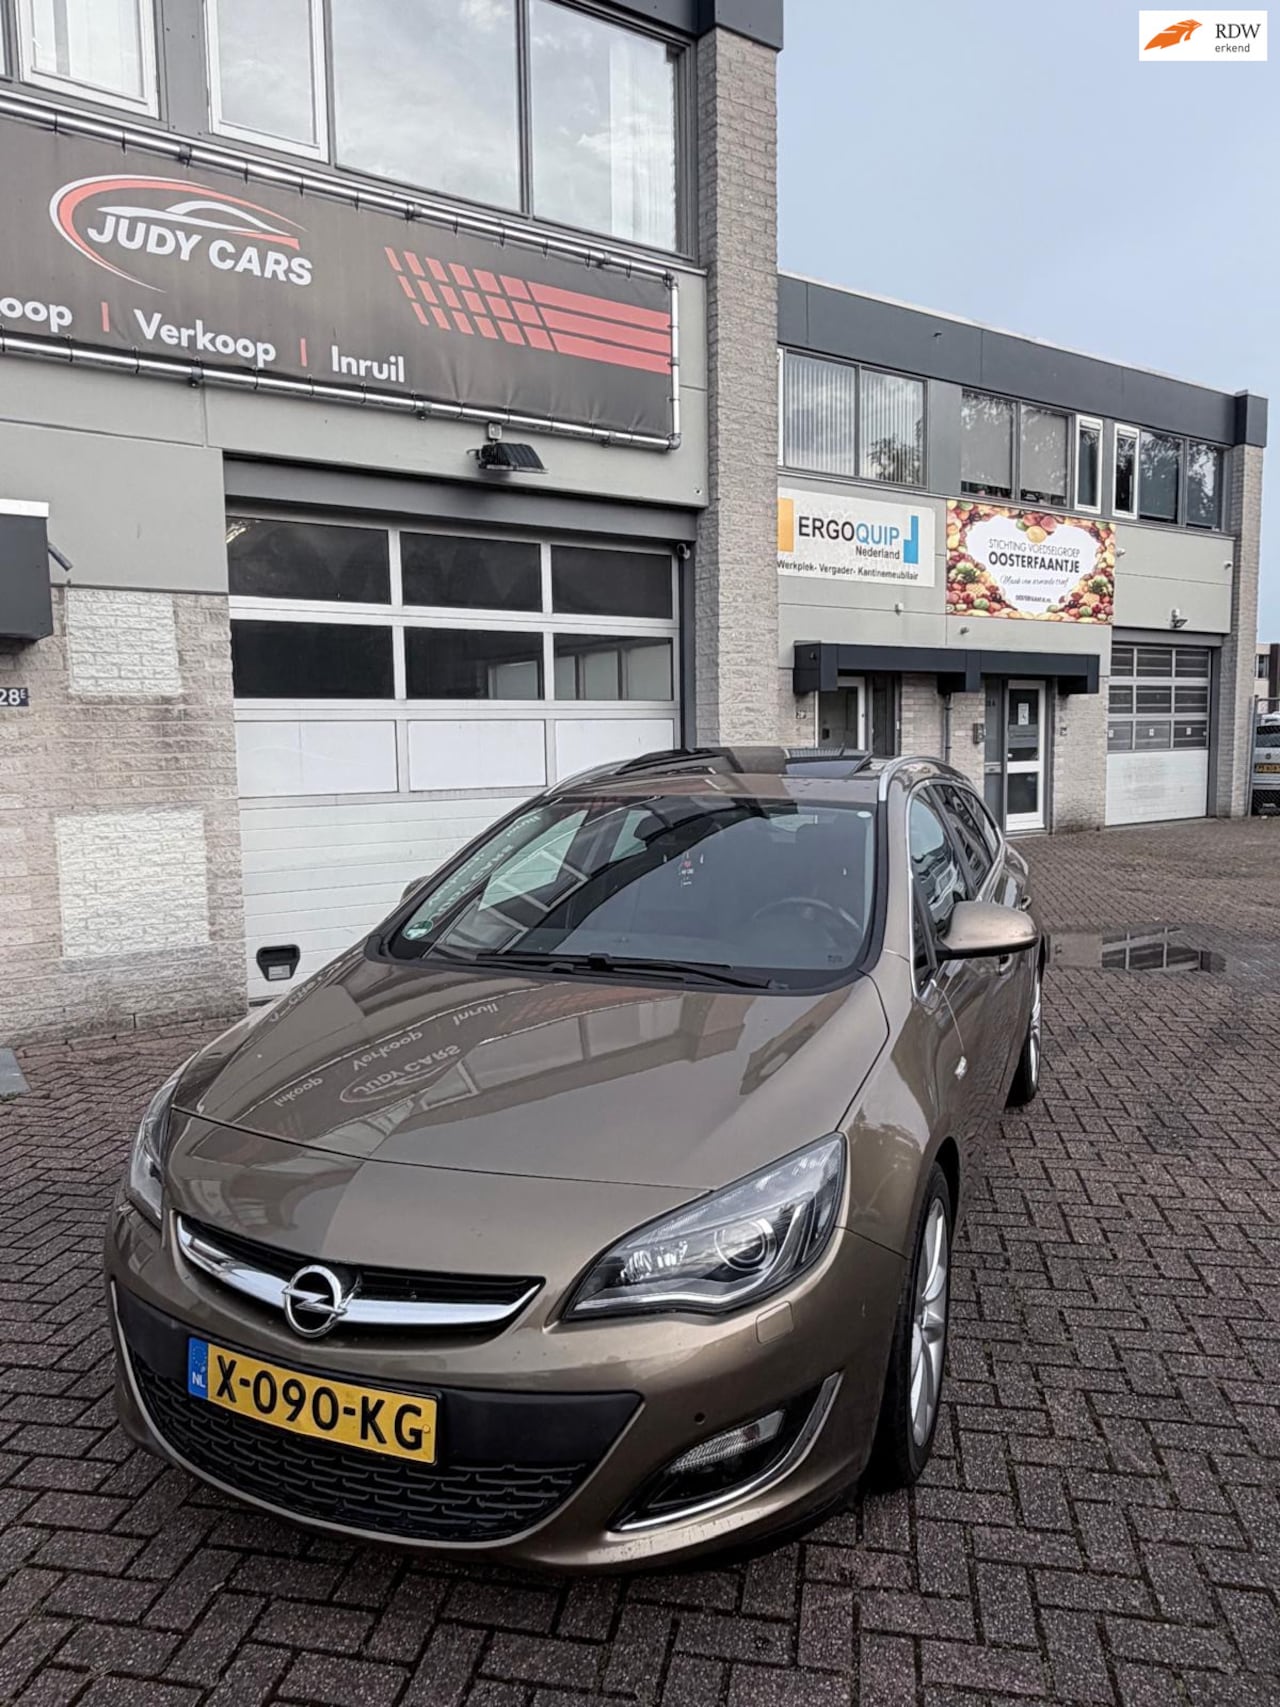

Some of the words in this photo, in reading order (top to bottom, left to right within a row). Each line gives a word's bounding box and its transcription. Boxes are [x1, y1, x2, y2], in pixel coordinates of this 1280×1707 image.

[87, 215, 201, 261] JUDY
[208, 240, 312, 286] CARS
[0, 297, 72, 333] oop
[134, 308, 276, 368] Verkoop
[331, 345, 405, 383] Inruil
[798, 515, 900, 545] ERGOQUIP
[855, 546, 900, 560] Nederland
[988, 539, 1026, 552] STICHTING
[1028, 544, 1080, 558] VOEDSELGROEP
[988, 551, 1080, 573] OOSTERFAANTJE
[192, 1372, 206, 1389] NL
[216, 1355, 423, 1451] X-090-KG
